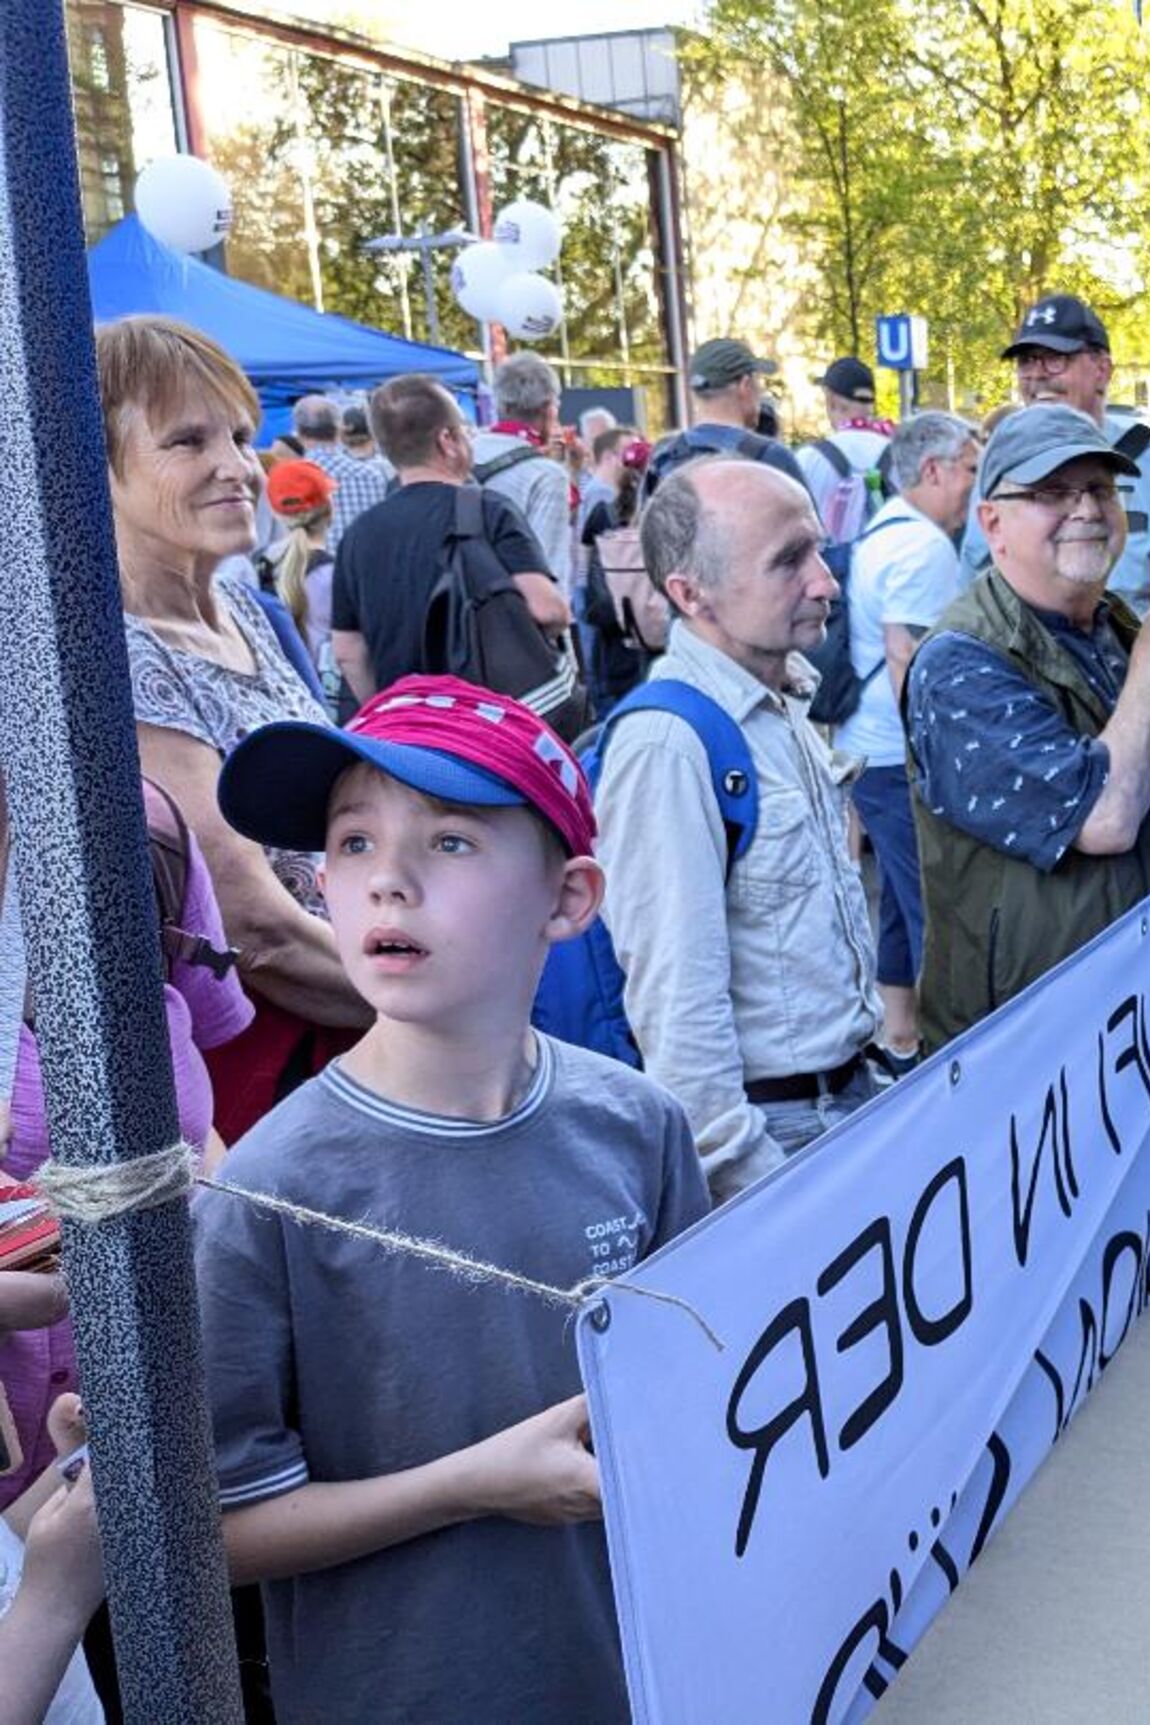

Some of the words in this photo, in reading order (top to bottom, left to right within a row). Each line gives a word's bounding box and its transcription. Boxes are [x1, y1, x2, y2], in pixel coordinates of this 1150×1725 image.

[879, 321, 908, 362] U
[585, 1216, 628, 1239] COAST
[592, 1242, 611, 1257] TO
